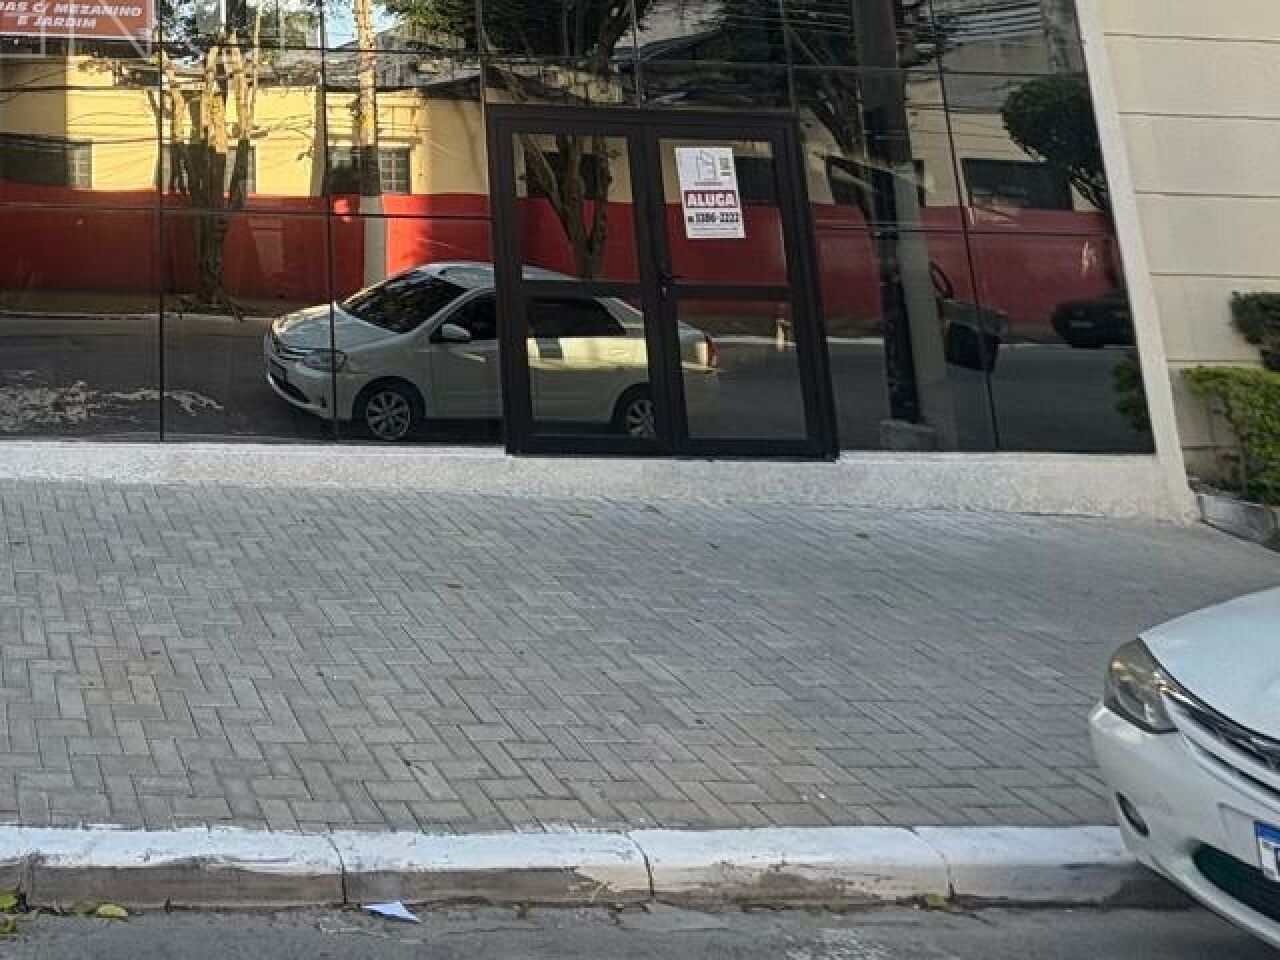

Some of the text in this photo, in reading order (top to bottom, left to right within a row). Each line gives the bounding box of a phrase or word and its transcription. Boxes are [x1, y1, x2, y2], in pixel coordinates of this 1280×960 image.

[54, 3, 142, 17] MEZANINO
[33, 17, 97, 28] JARDIM
[687, 193, 735, 207] ALUGA
